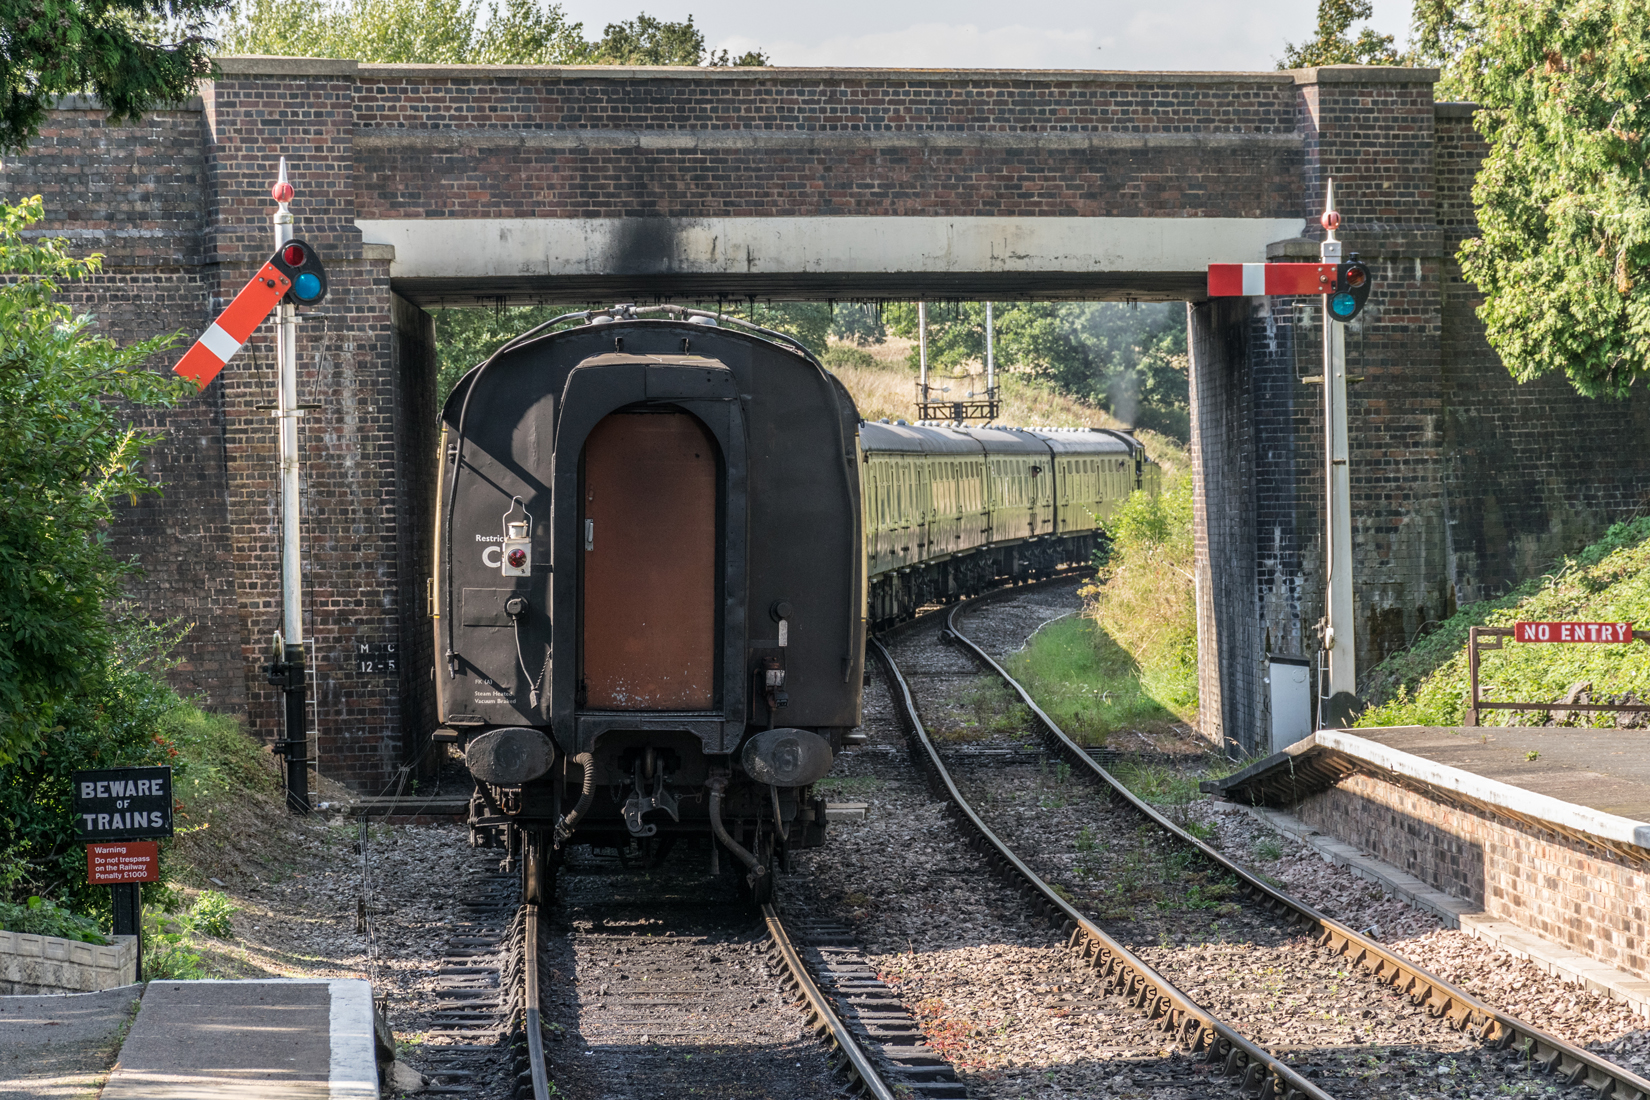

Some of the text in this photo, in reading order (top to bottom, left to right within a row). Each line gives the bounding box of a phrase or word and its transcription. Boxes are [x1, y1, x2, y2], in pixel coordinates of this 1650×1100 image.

[1524, 624, 1627, 641] NO ENTRY
[360, 643, 395, 654] M C
[361, 661, 373, 673] 12
[388, 660, 396, 671] 5
[80, 779, 163, 798] BEWARE
[116, 800, 130, 808] OF
[83, 812, 163, 830] TRAINS
[94, 846, 127, 854] Warning
